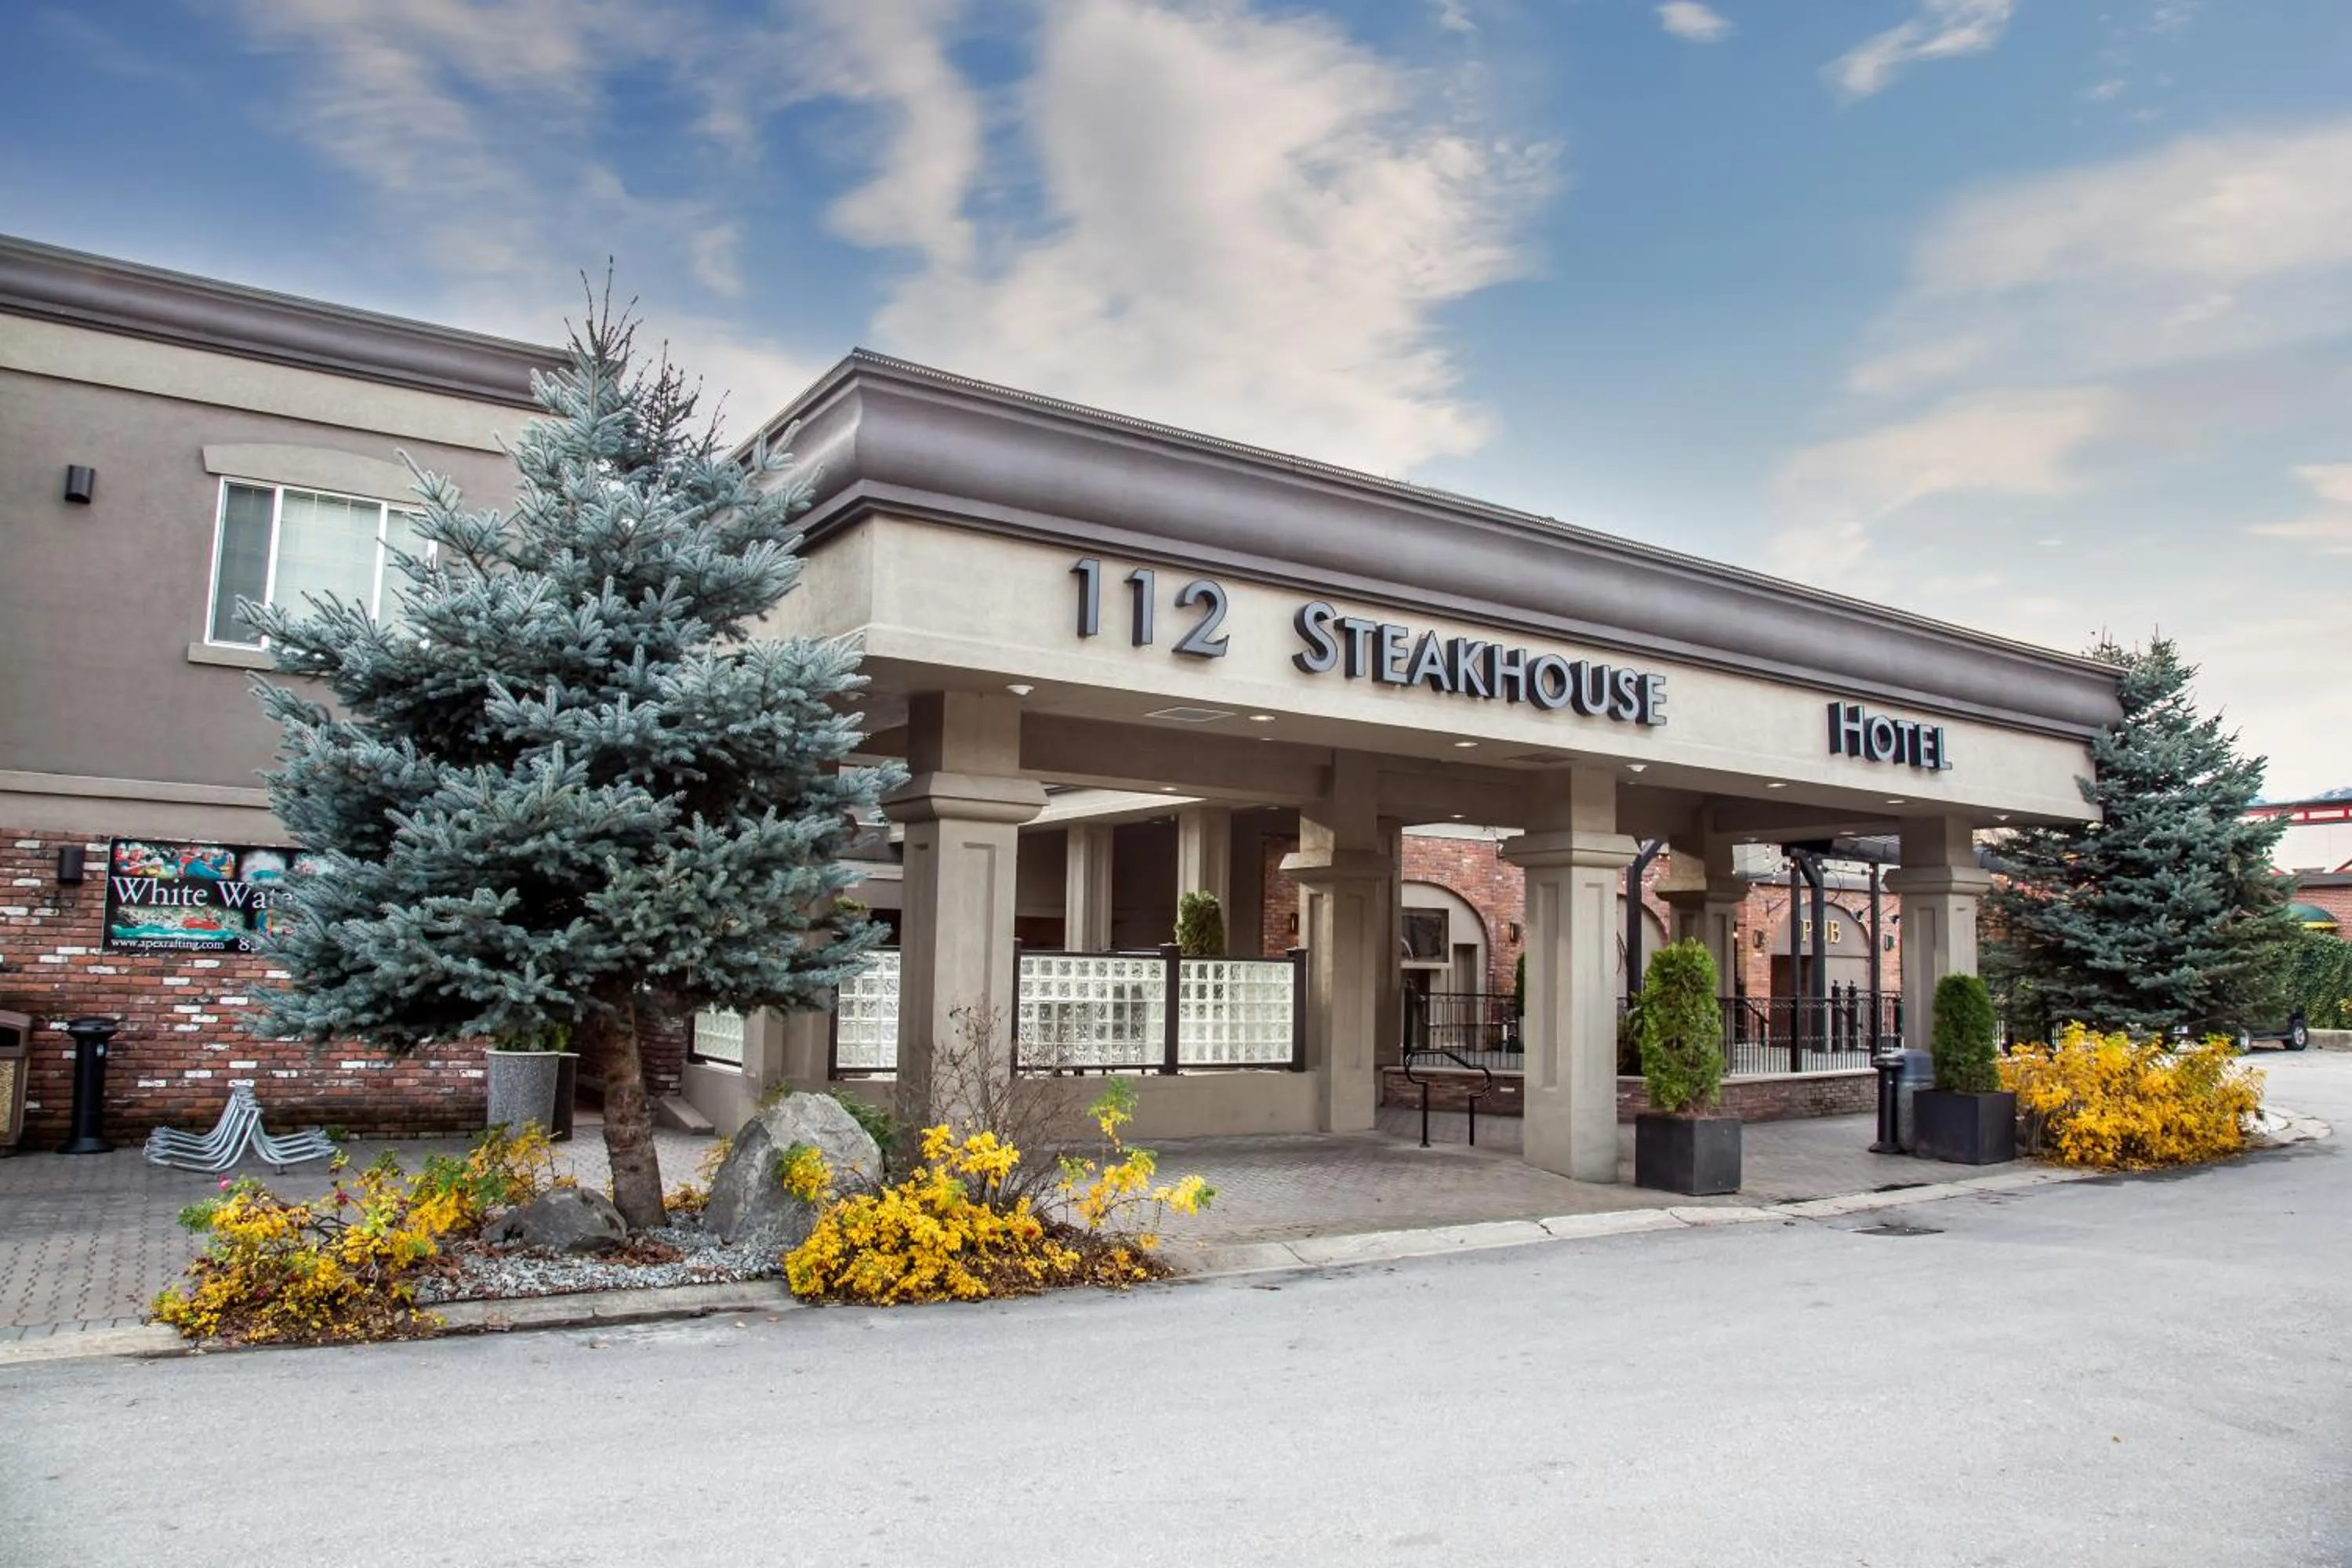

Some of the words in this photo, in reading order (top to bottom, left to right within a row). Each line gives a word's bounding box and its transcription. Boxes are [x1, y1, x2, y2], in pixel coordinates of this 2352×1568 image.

[1069, 557, 1229, 659] 112
[1292, 601, 1668, 726] STEAKHOUSE
[1828, 702, 1952, 771] HOTEL
[111, 876, 208, 906] White
[110, 938, 225, 950] www.apexrafting.com
[1800, 920, 1841, 944] PB
